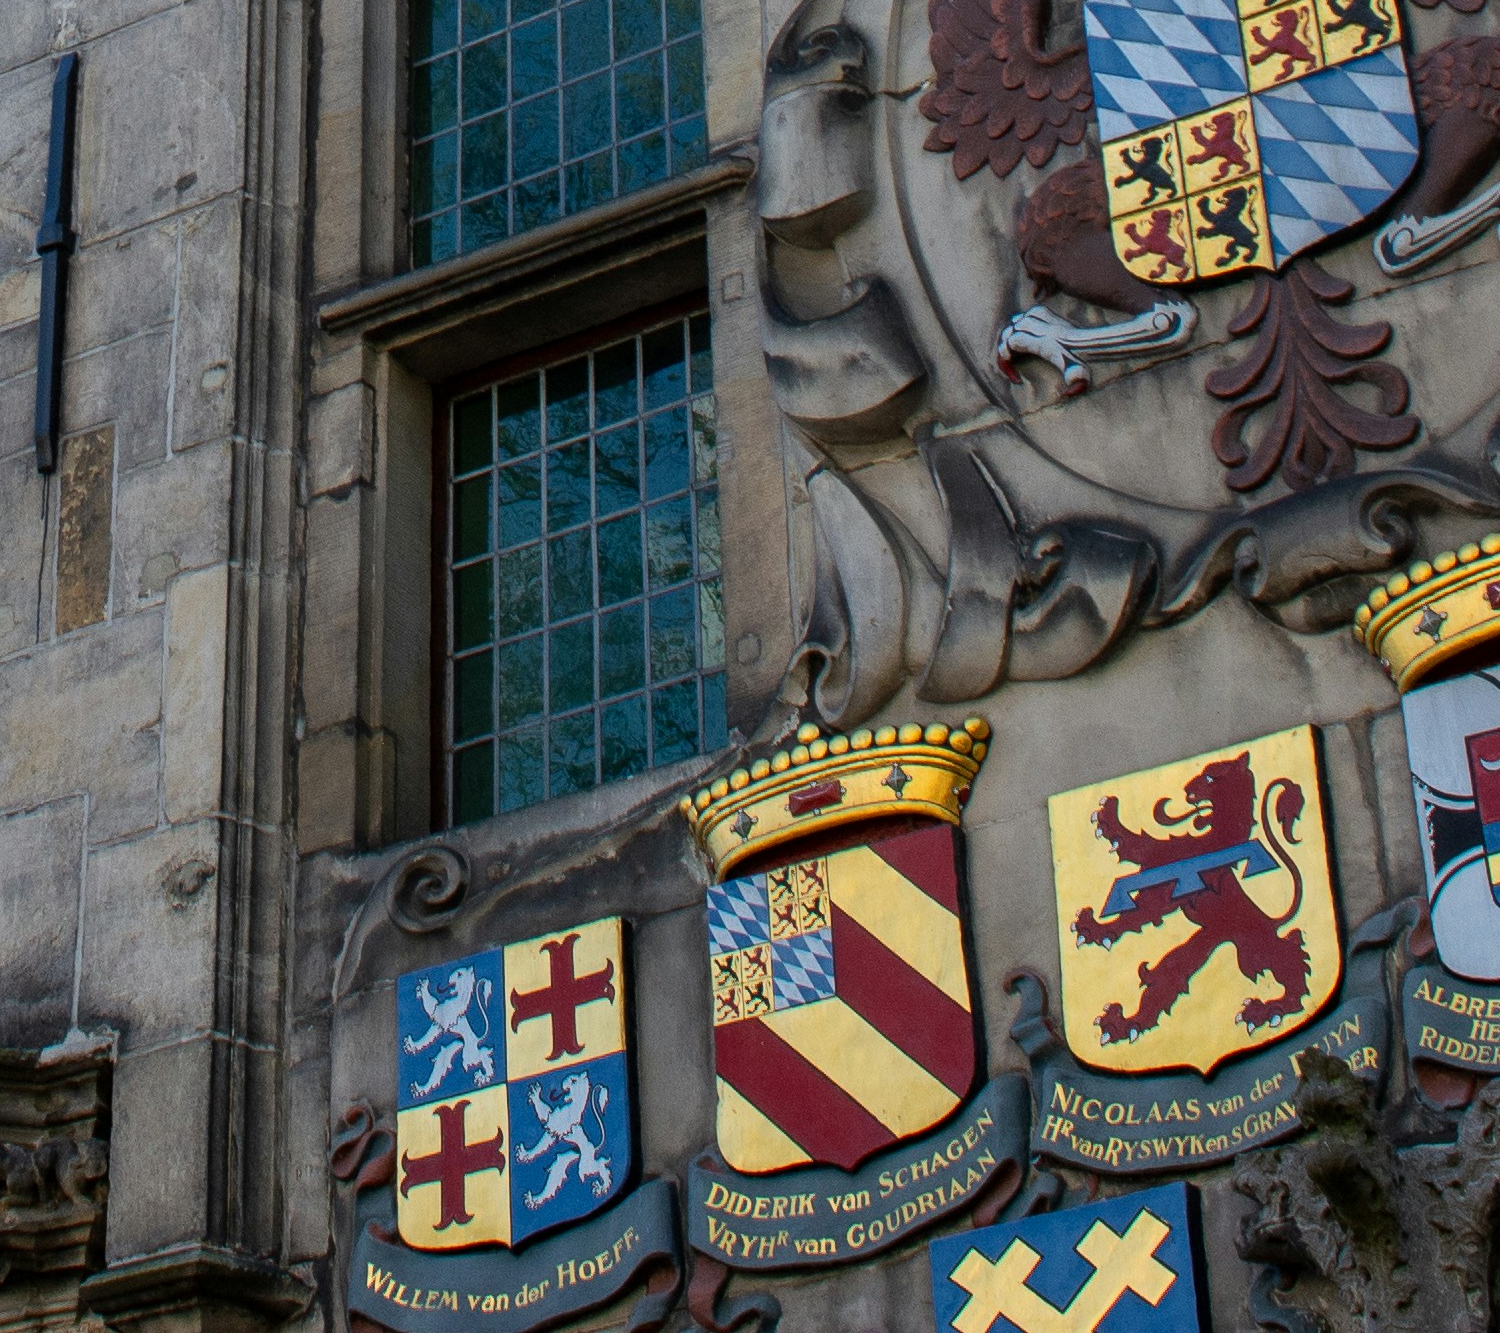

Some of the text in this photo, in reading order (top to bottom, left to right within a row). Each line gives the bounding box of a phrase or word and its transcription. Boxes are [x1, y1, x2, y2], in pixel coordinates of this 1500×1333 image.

[1050, 1082, 1202, 1126] NICOLAAS
[1206, 1094, 1245, 1119] van
[1250, 1072, 1283, 1103] der
[704, 1107, 995, 1220] DIDERIK van SCHAGEN
[1070, 1137, 1105, 1162] van
[1104, 1135, 1207, 1167] RYSWYK
[794, 1236, 838, 1256] van
[846, 1147, 998, 1249] GOUDRIAAN
[365, 1225, 641, 1313] WILLEM van der HOEFF.
